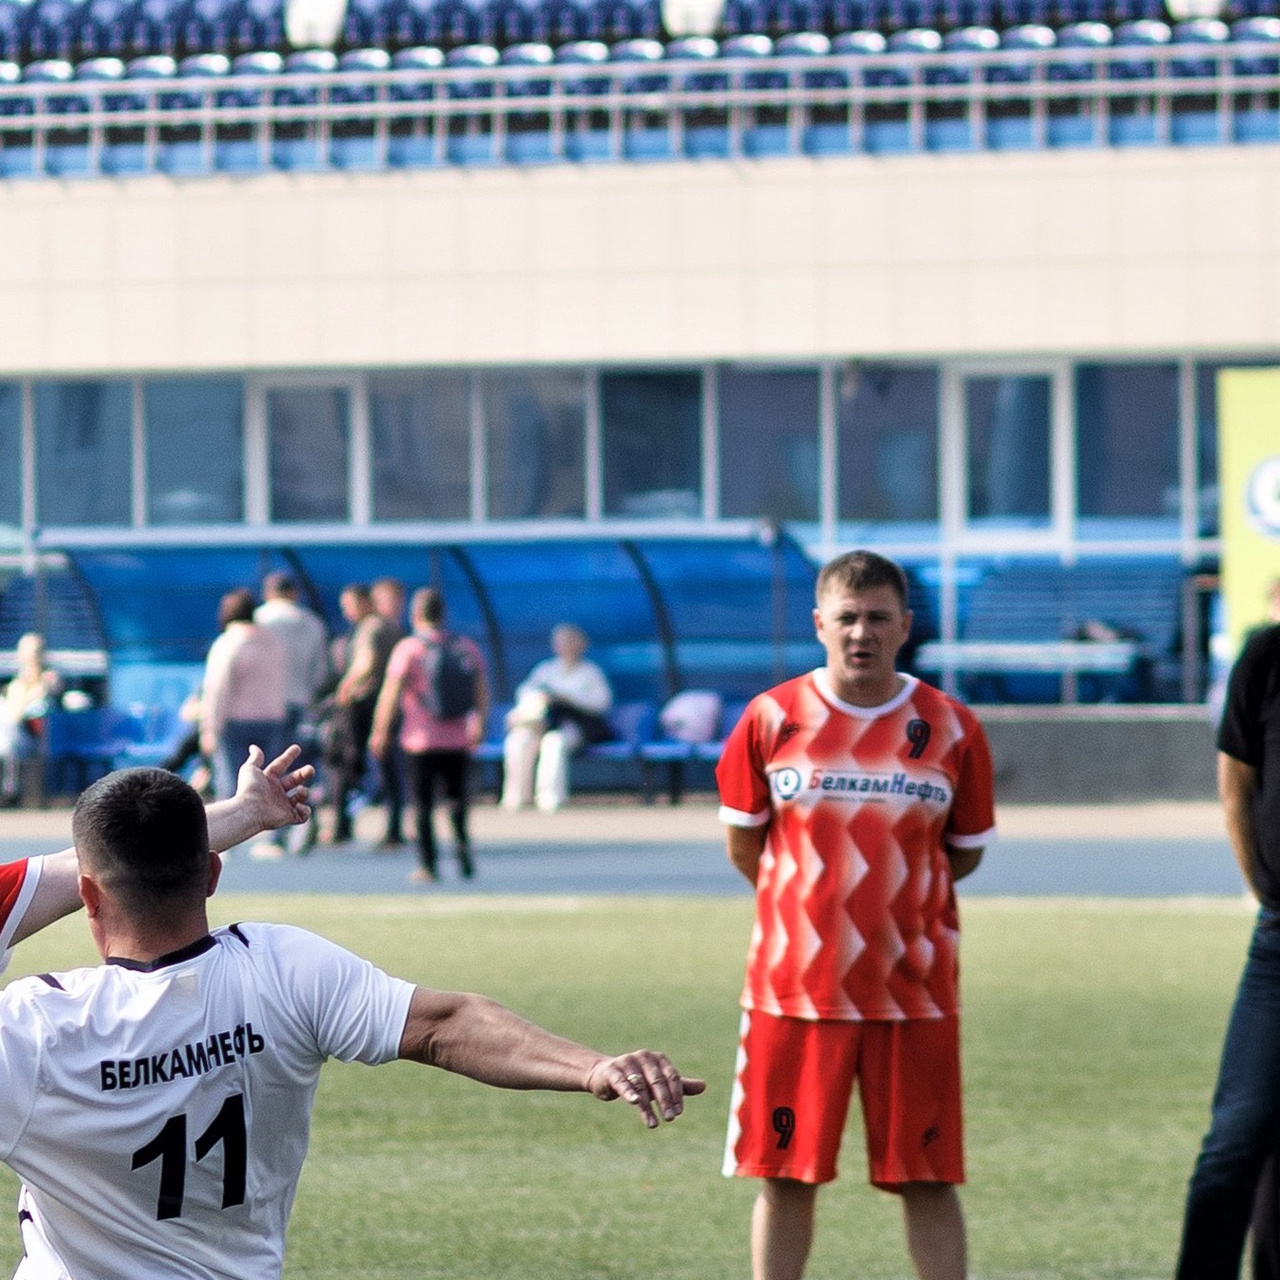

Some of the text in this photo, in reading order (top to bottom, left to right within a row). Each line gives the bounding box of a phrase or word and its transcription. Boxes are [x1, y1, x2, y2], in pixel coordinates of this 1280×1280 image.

[906, 718, 930, 759] 9
[809, 770, 947, 803] БелкамНефть
[772, 1106, 795, 1150] 9
[131, 1092, 247, 1221] 11
